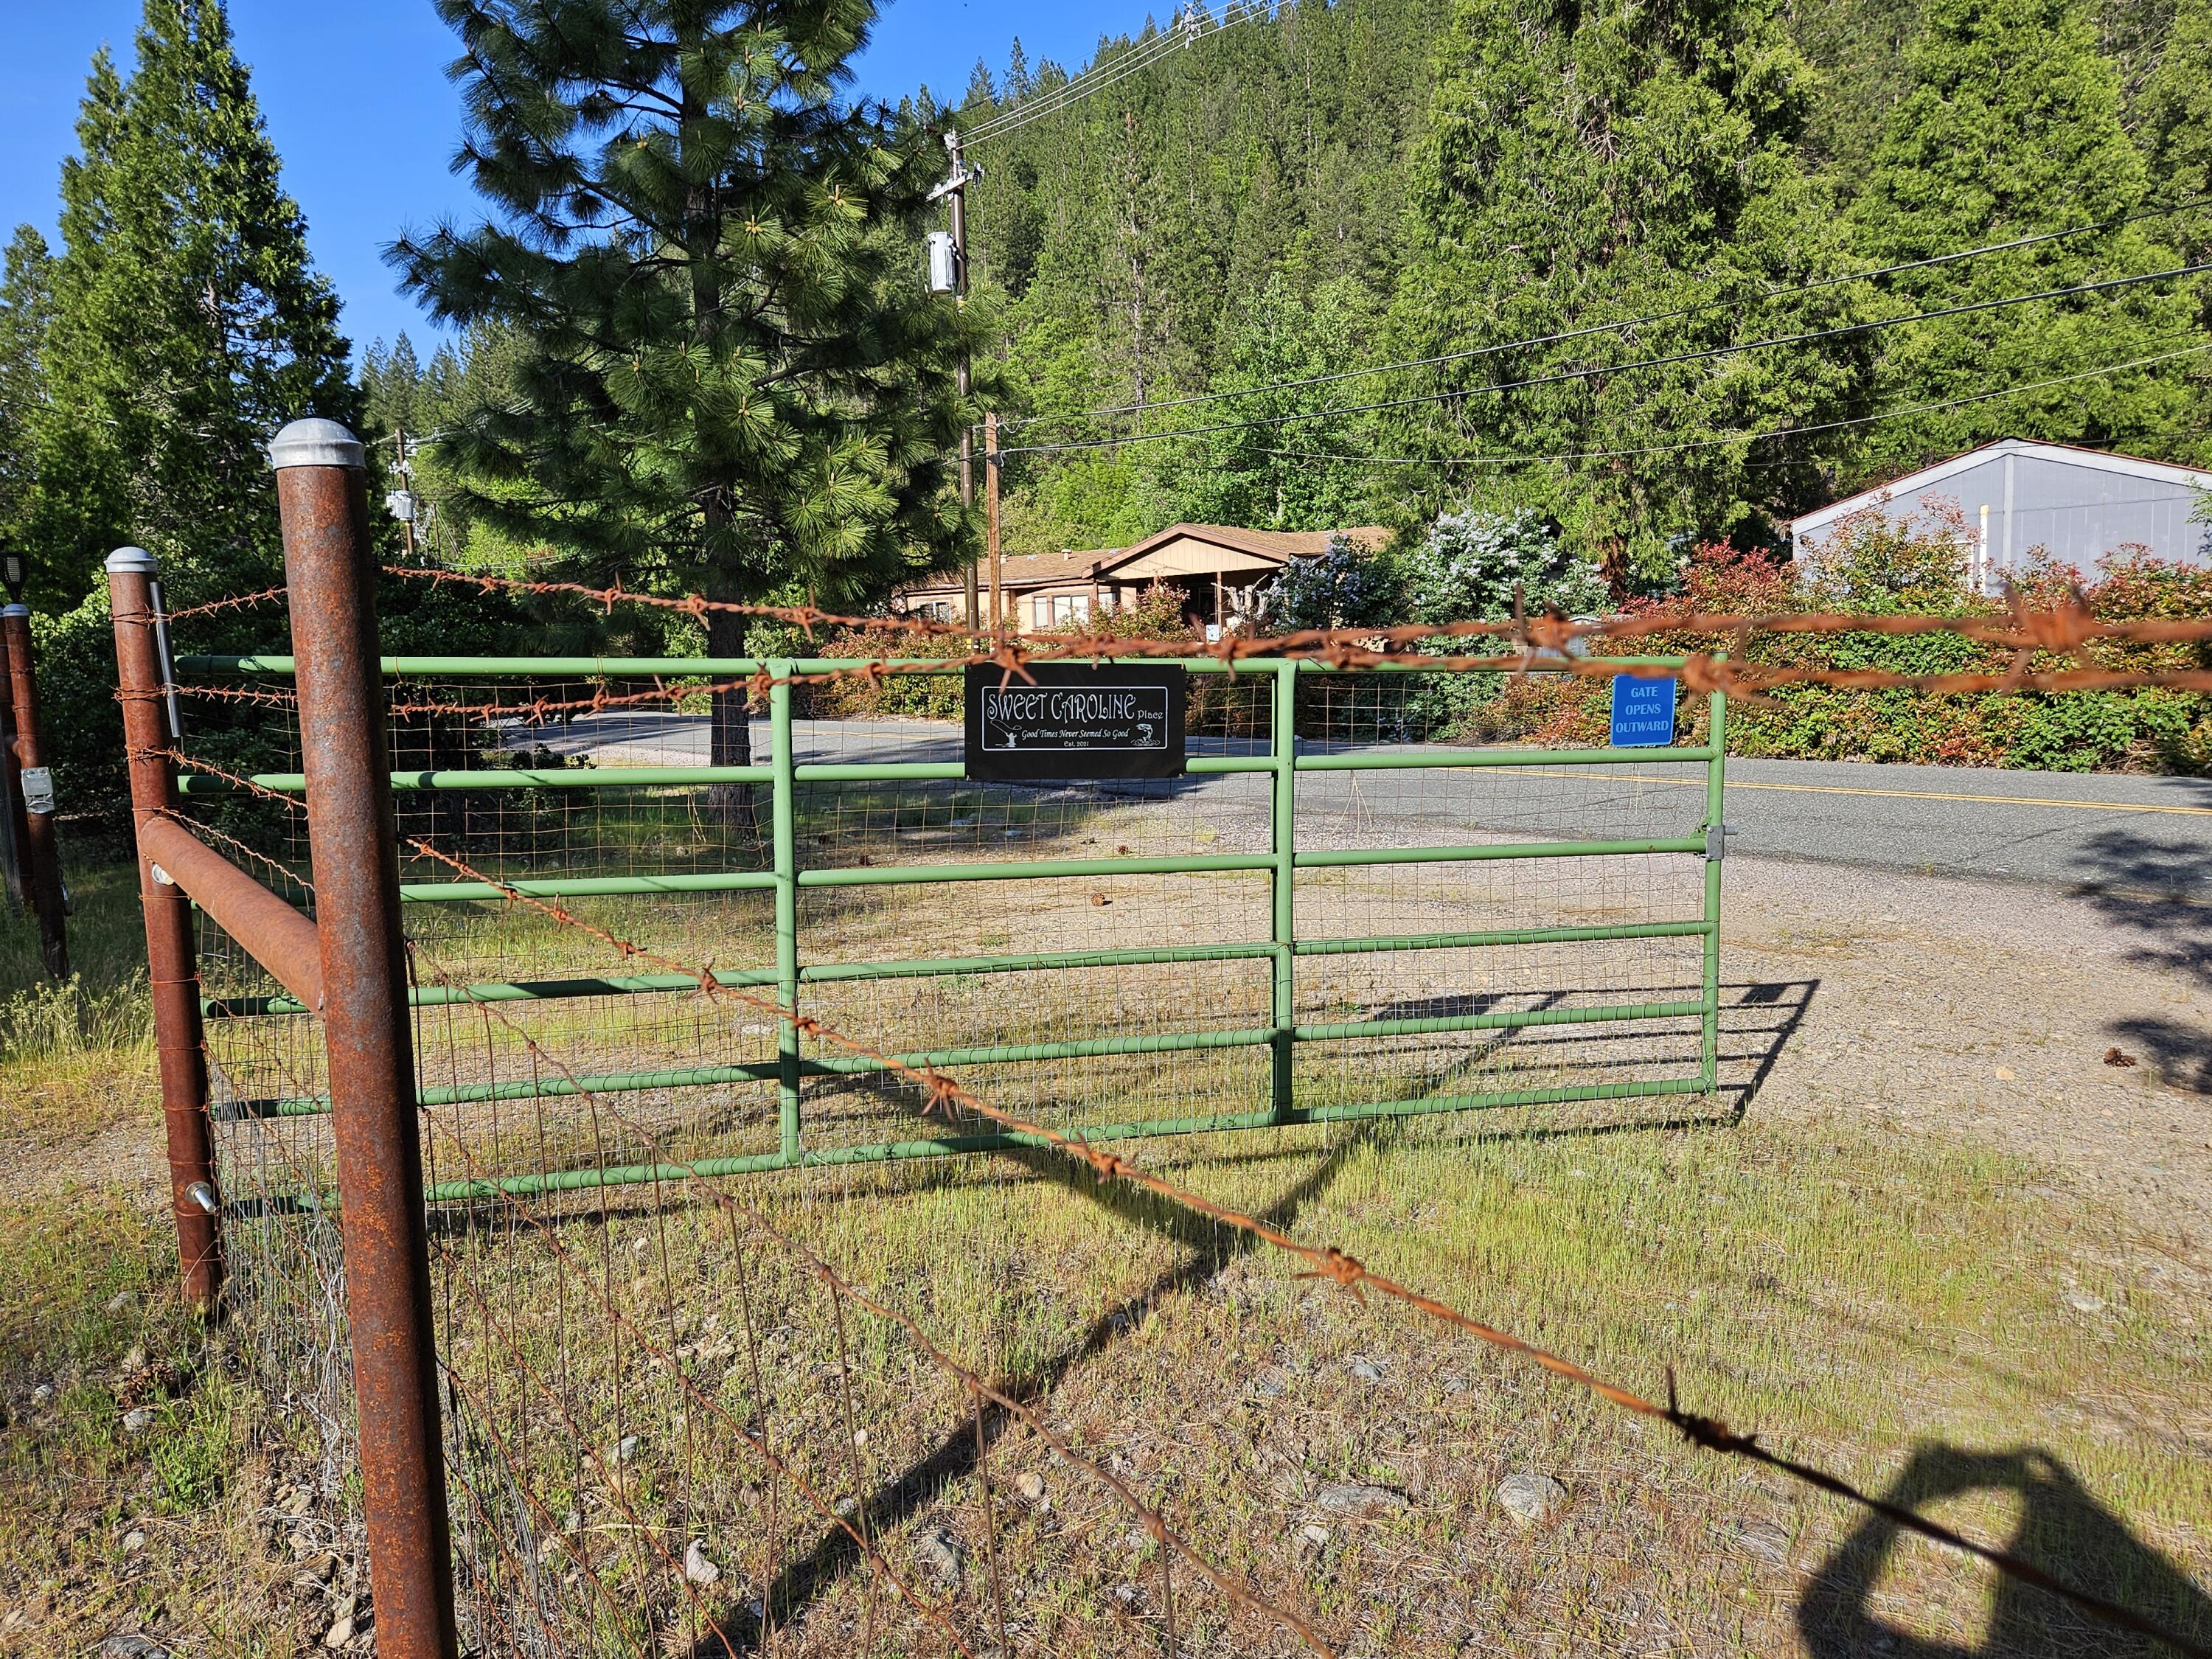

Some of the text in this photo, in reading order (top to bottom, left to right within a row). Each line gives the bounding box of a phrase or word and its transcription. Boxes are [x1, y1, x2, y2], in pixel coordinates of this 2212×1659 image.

[1630, 686, 1658, 698] GATE
[987, 692, 1164, 724] SWEET CAROLINE Place
[1625, 703, 1661, 715] OPENS
[1615, 720, 1669, 733] OUTWARD
[1021, 728, 1130, 740] Good Times Never Seemed So Good
